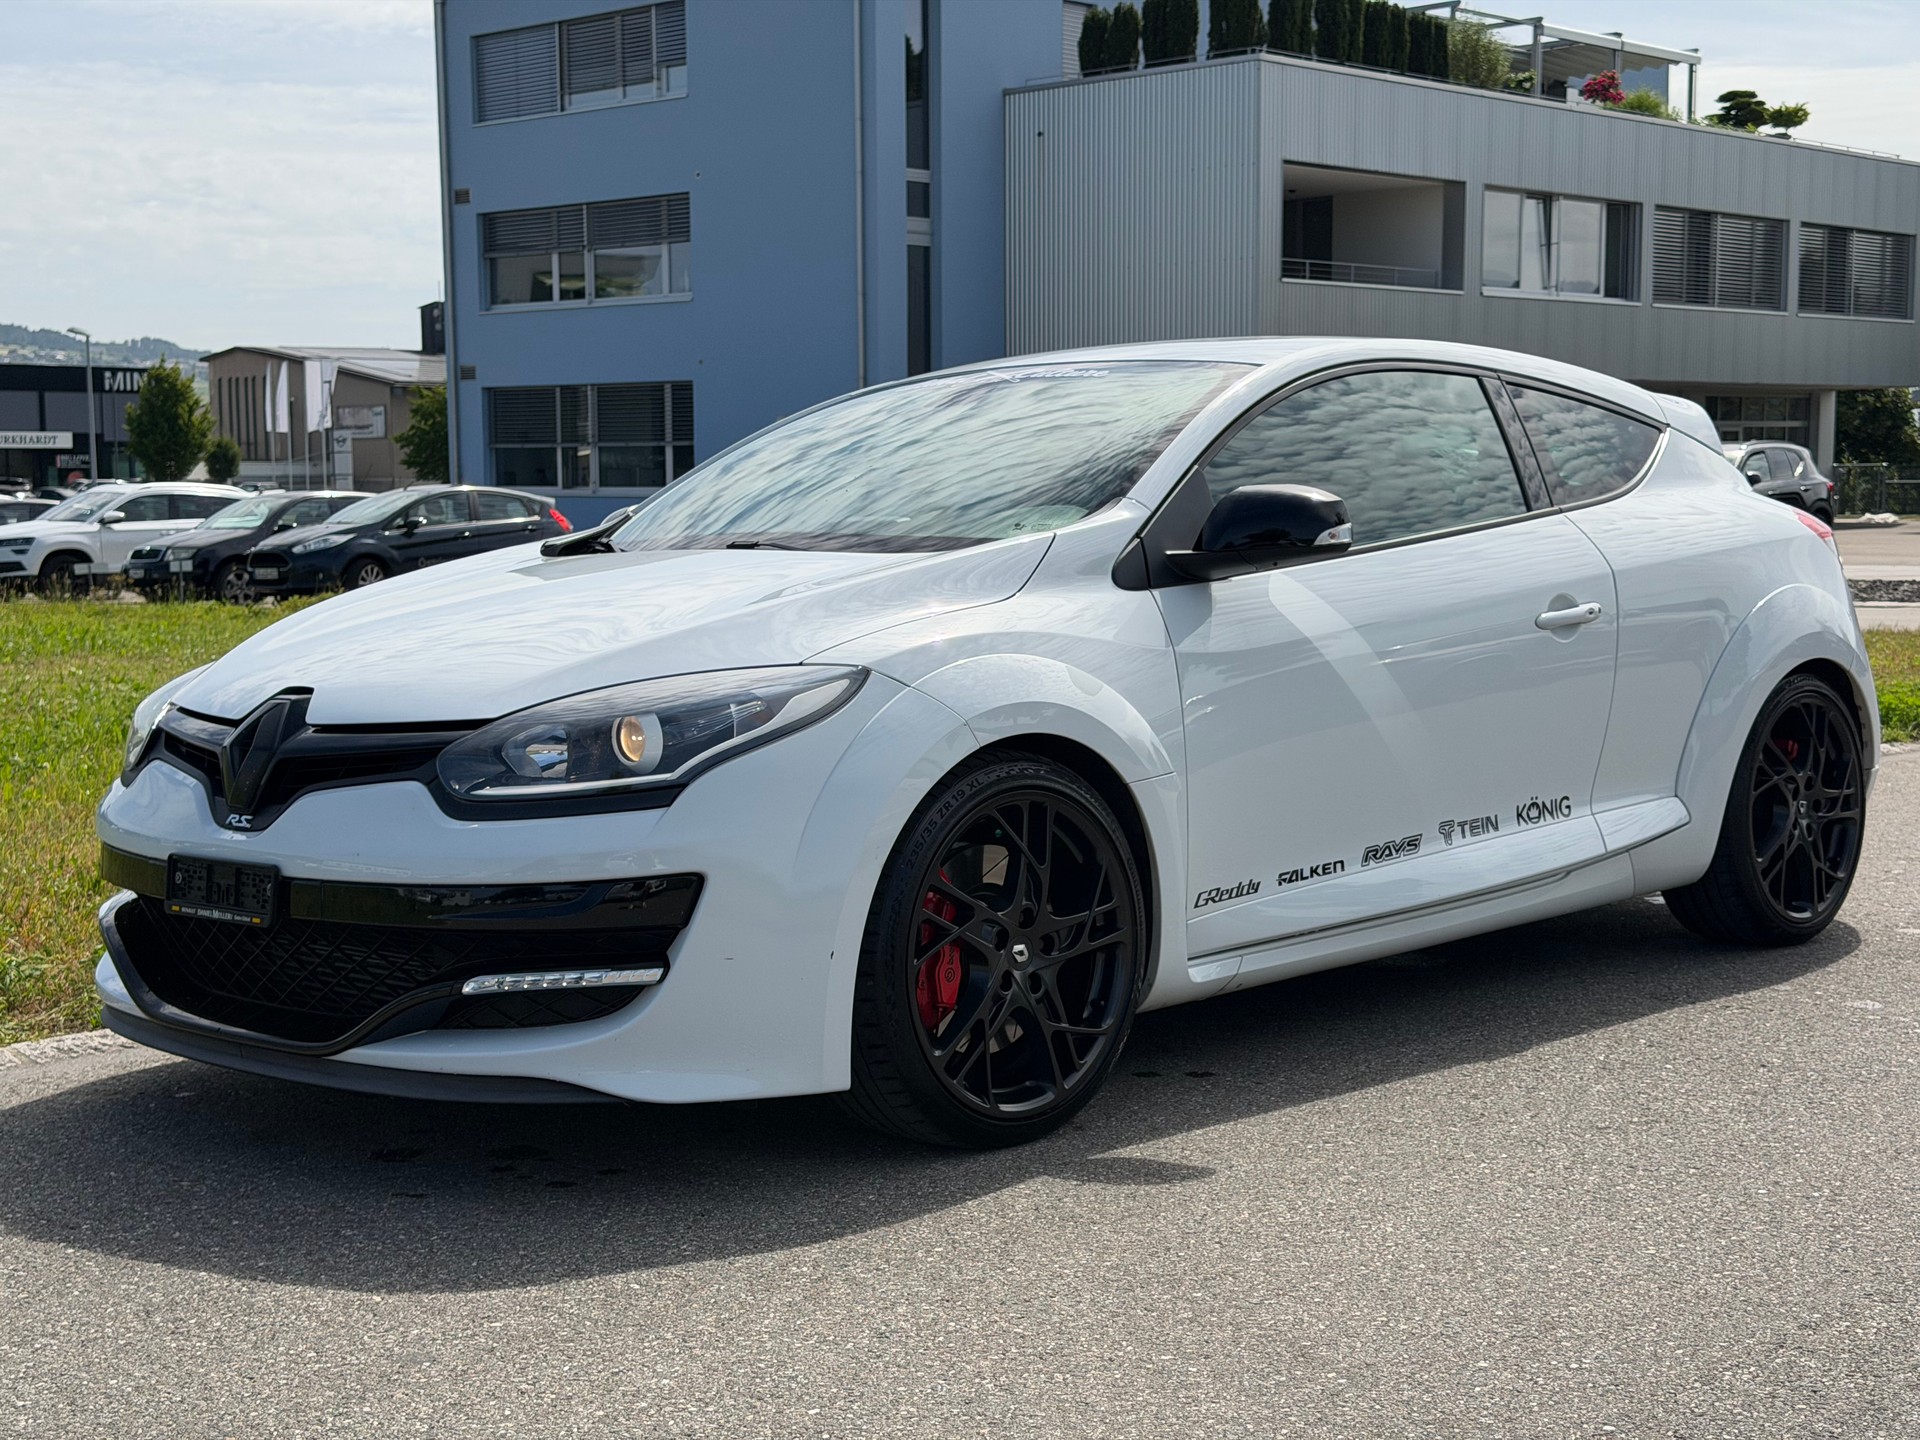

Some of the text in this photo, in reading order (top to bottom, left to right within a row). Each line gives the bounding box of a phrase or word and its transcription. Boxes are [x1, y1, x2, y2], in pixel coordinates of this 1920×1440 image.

[104, 371, 154, 391] MIN
[906, 818, 938, 870] 235/35
[967, 777, 984, 792] XL
[1457, 814, 1500, 839] TEIN
[1516, 795, 1571, 827] KÖNIG
[1361, 833, 1423, 867] RAYS
[1276, 859, 1345, 887] FALKEN
[1194, 878, 1261, 909] GReddy
